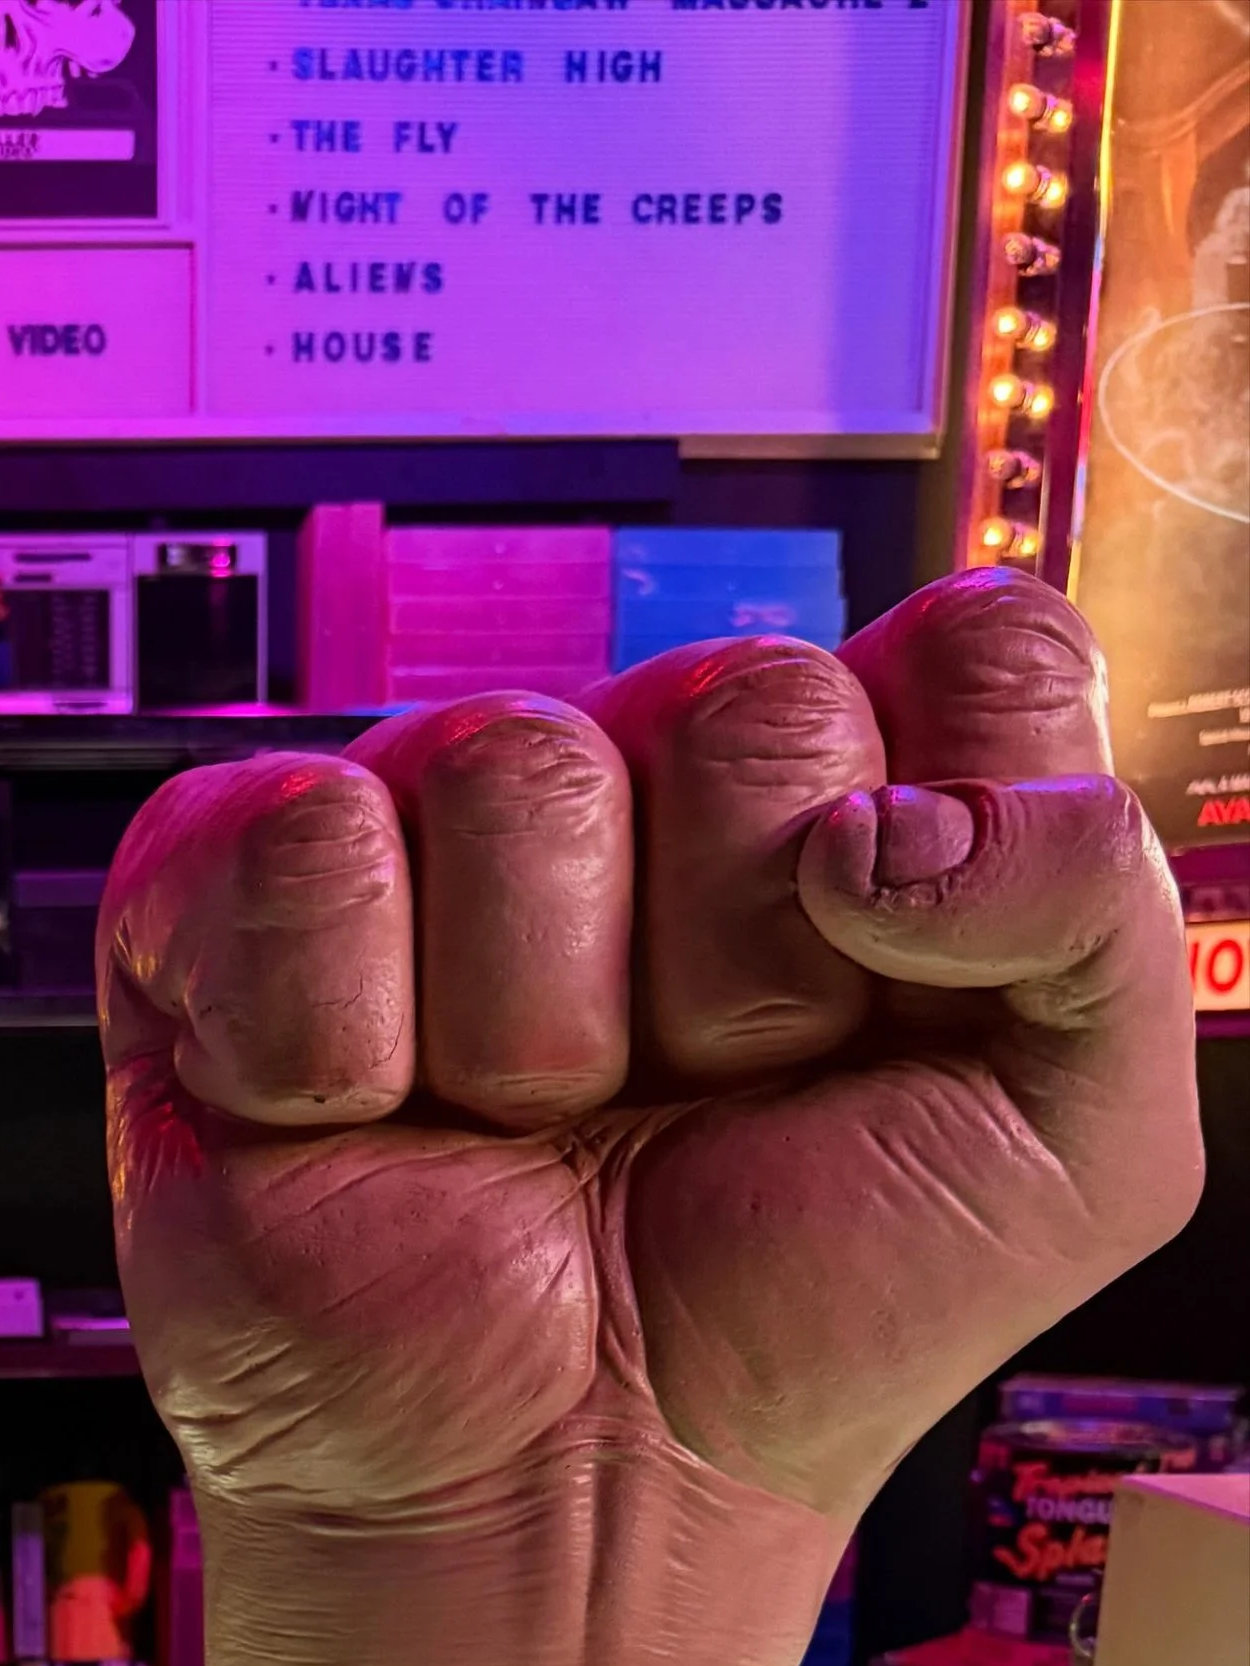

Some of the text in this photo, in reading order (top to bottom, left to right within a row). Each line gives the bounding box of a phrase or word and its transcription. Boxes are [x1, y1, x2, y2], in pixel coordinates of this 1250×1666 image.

[291, 48, 663, 83] SLAUGHTER HIGH
[291, 120, 459, 154] THE FLY
[443, 192, 489, 224] OF
[530, 193, 600, 225] THE
[631, 192, 784, 225] CREEPS
[293, 261, 444, 295] ALIENS
[7, 323, 107, 356] VIDEO
[293, 332, 432, 363] HOUSE
